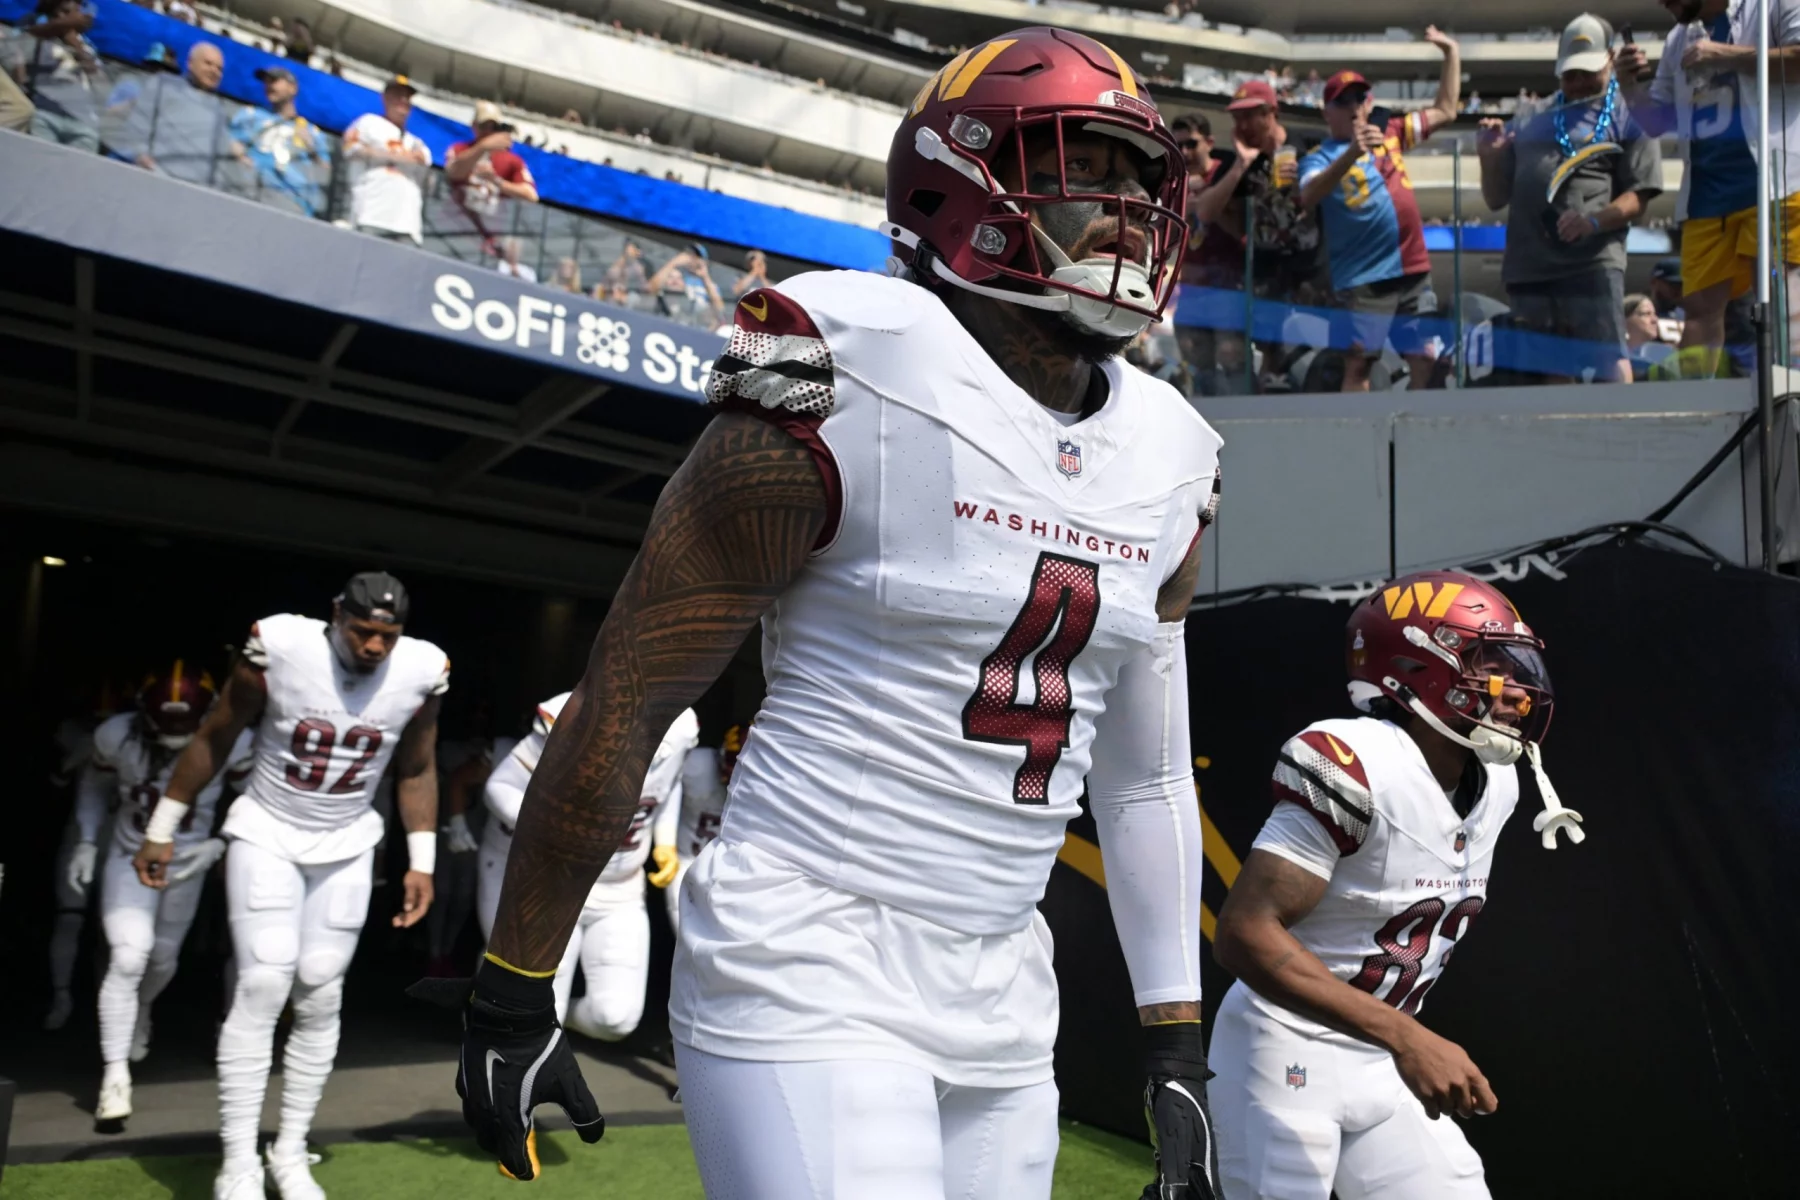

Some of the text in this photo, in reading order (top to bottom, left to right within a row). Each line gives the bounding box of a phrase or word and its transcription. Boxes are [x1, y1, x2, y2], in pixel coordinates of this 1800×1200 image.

[431, 274, 567, 356] SoFi
[1060, 453, 1079, 471] NFL
[953, 500, 1150, 563] WASHINGTON
[961, 551, 1101, 805] 4
[285, 717, 382, 794] 92
